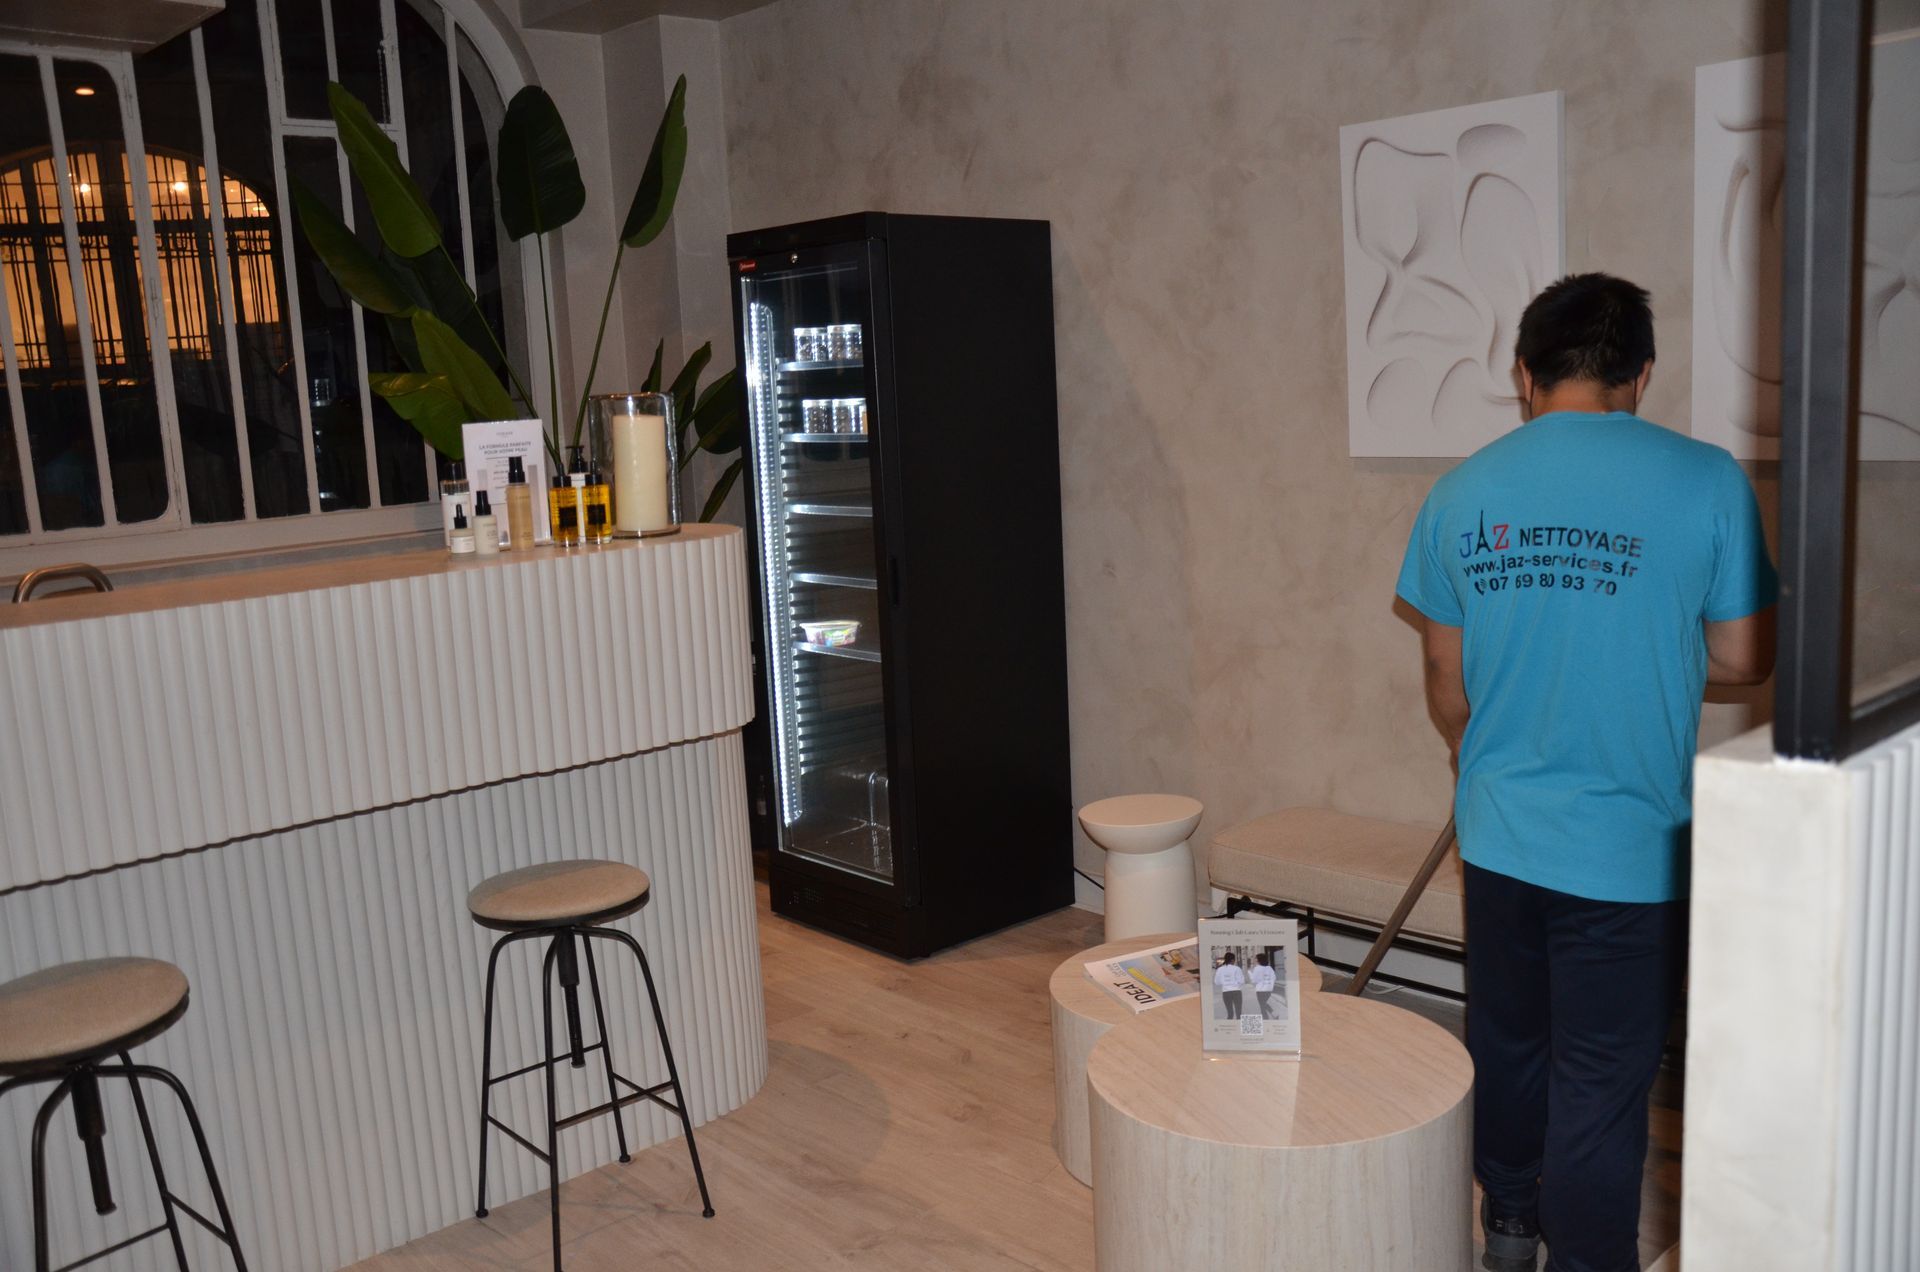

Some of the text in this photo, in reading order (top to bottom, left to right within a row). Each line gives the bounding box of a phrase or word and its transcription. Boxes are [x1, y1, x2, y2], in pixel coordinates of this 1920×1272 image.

[1459, 509, 1645, 559] JAZ NETTOYAGE
[1463, 552, 1639, 579] www.jaz-services.fr
[1489, 576, 1509, 591] 07
[1539, 572, 1555, 588] 80
[1561, 574, 1585, 591] 93
[1592, 579, 1618, 596] 70
[1113, 981, 1156, 1004] IDEAT
